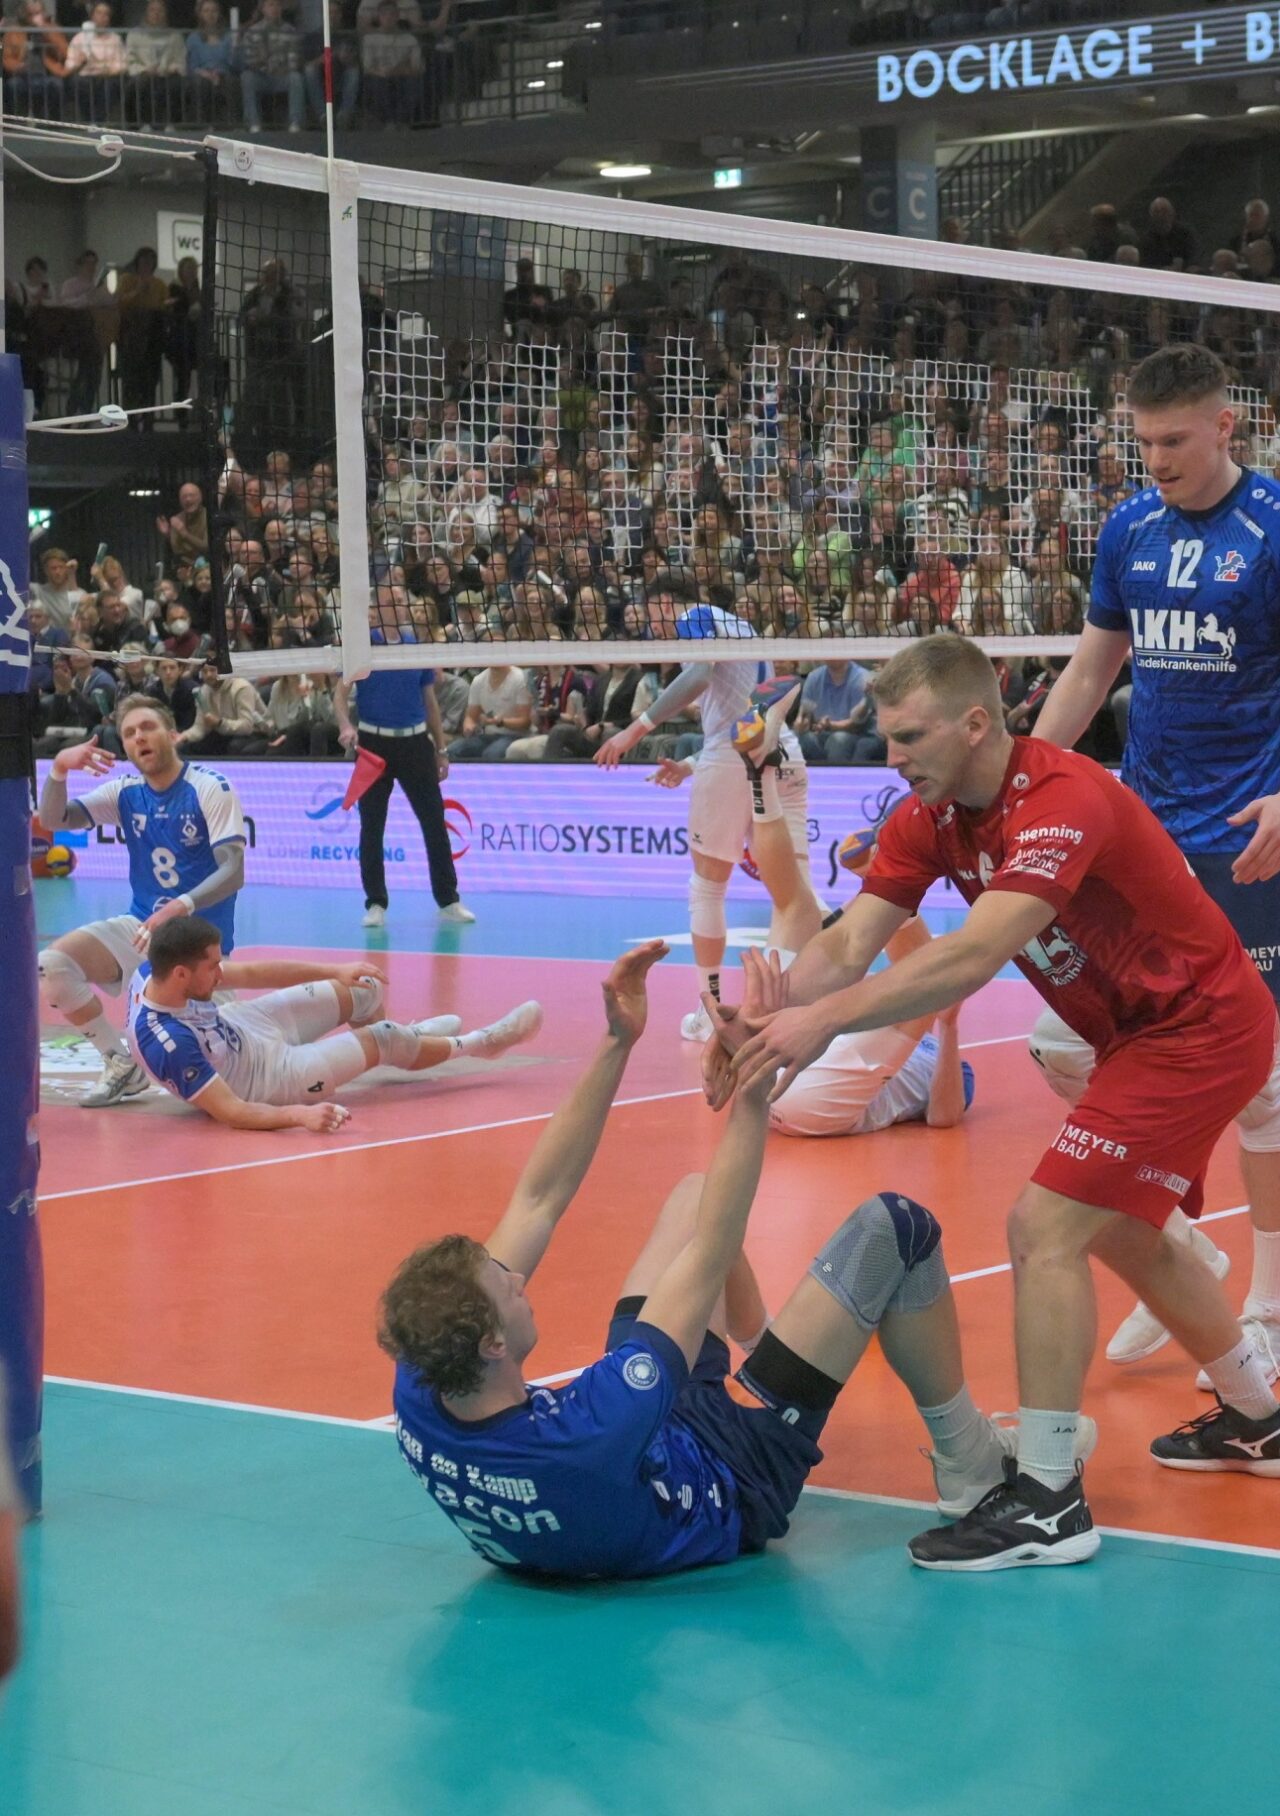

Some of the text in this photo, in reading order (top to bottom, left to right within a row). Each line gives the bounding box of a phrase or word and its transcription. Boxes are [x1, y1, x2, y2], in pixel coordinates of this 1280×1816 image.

[876, 24, 1153, 103] BOCKLAGE
[1181, 22, 1217, 65] +
[908, 186, 927, 220] C
[177, 235, 201, 251] WC
[1131, 561, 1156, 572] JAKO
[1166, 538, 1204, 589] 12
[1130, 608, 1196, 651] LKH
[481, 823, 689, 855] RATIOSYSTEMS
[1017, 824, 1084, 845] Henning
[151, 846, 181, 889] 8
[1255, 960, 1273, 972] AU
[1057, 1138, 1091, 1161] BAU
[1064, 1124, 1128, 1160] MEYER
